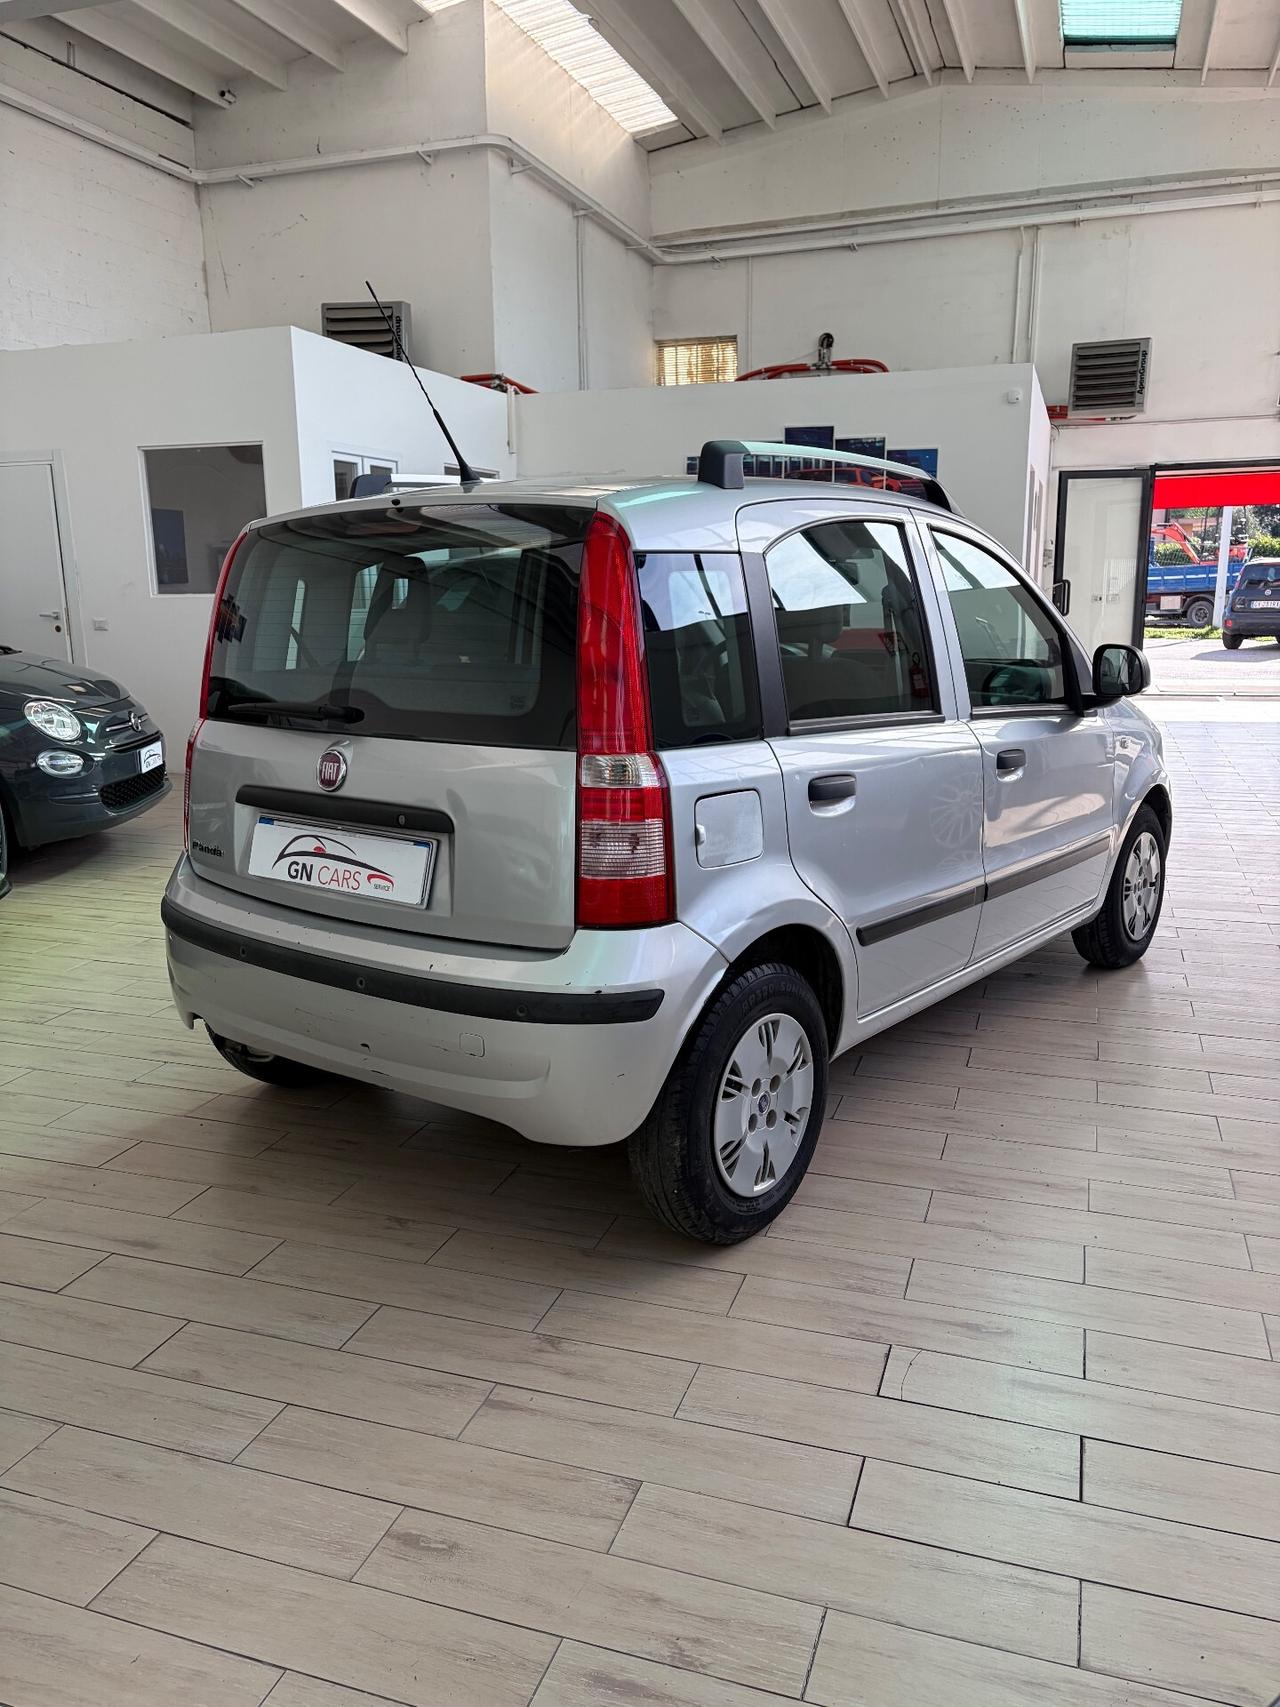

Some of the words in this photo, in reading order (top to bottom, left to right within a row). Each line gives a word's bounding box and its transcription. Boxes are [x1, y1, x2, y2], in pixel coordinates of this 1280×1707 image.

[1137, 350, 1148, 395] ApenGroup
[321, 761, 340, 781] FIAT
[192, 840, 223, 857] Panda
[287, 860, 314, 882] GN
[317, 865, 362, 891] CARS
[373, 883, 391, 892] SERVICE
